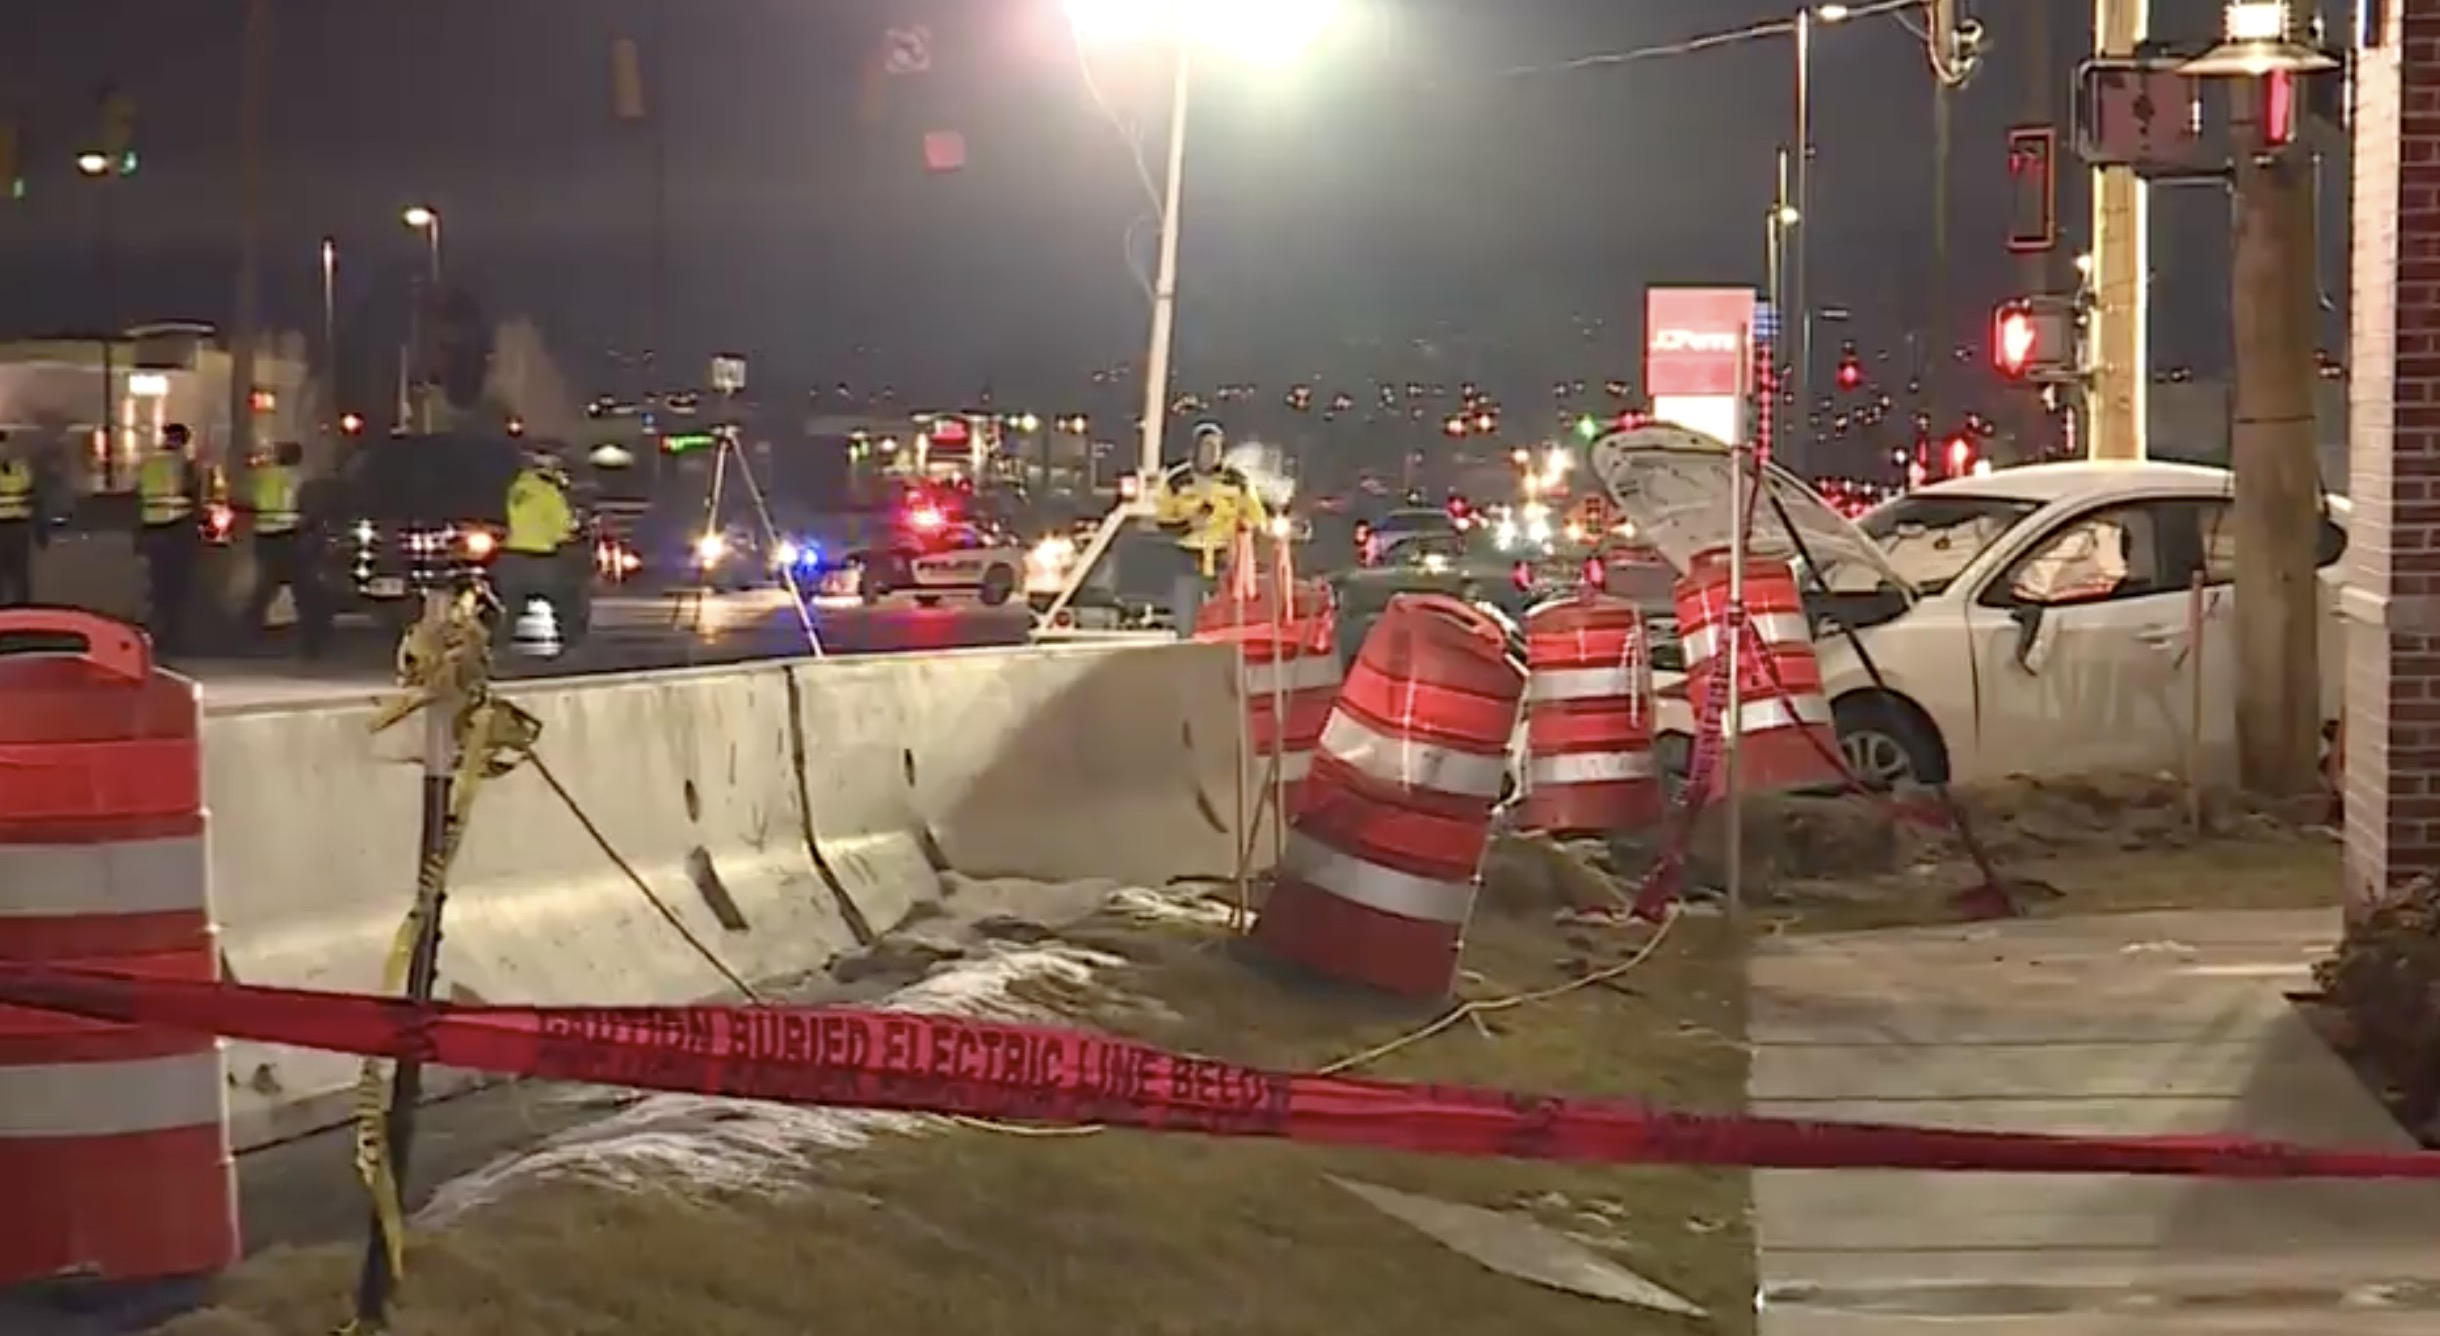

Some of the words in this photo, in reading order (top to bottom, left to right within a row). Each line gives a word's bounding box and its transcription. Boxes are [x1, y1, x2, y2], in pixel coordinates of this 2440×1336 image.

[731, 1010, 869, 1068] BURIED
[884, 1021, 1066, 1085] ELECTRIC
[1076, 1041, 1162, 1098] LINE
